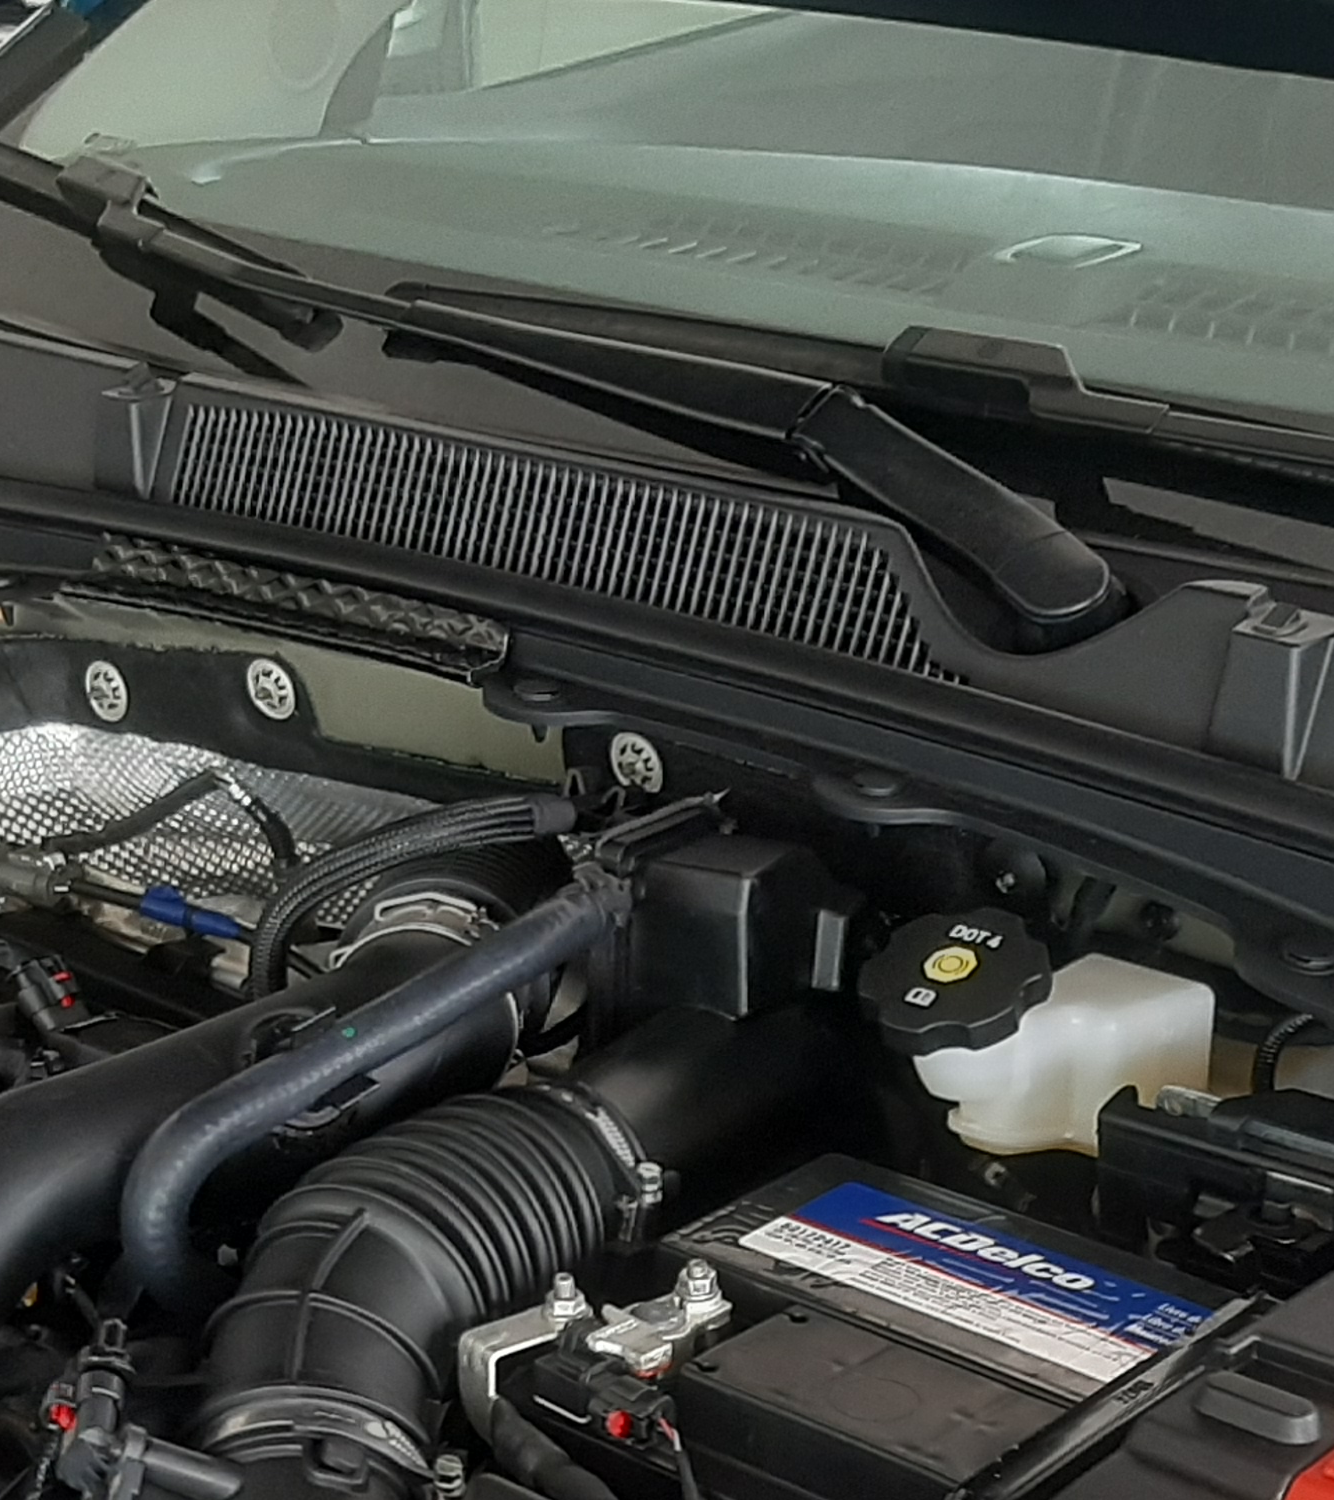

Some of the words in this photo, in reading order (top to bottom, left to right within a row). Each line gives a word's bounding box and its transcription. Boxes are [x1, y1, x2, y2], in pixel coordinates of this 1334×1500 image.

[949, 924, 991, 944] DOT
[987, 936, 1003, 948] 4
[875, 1212, 1095, 1291] ACDelco
